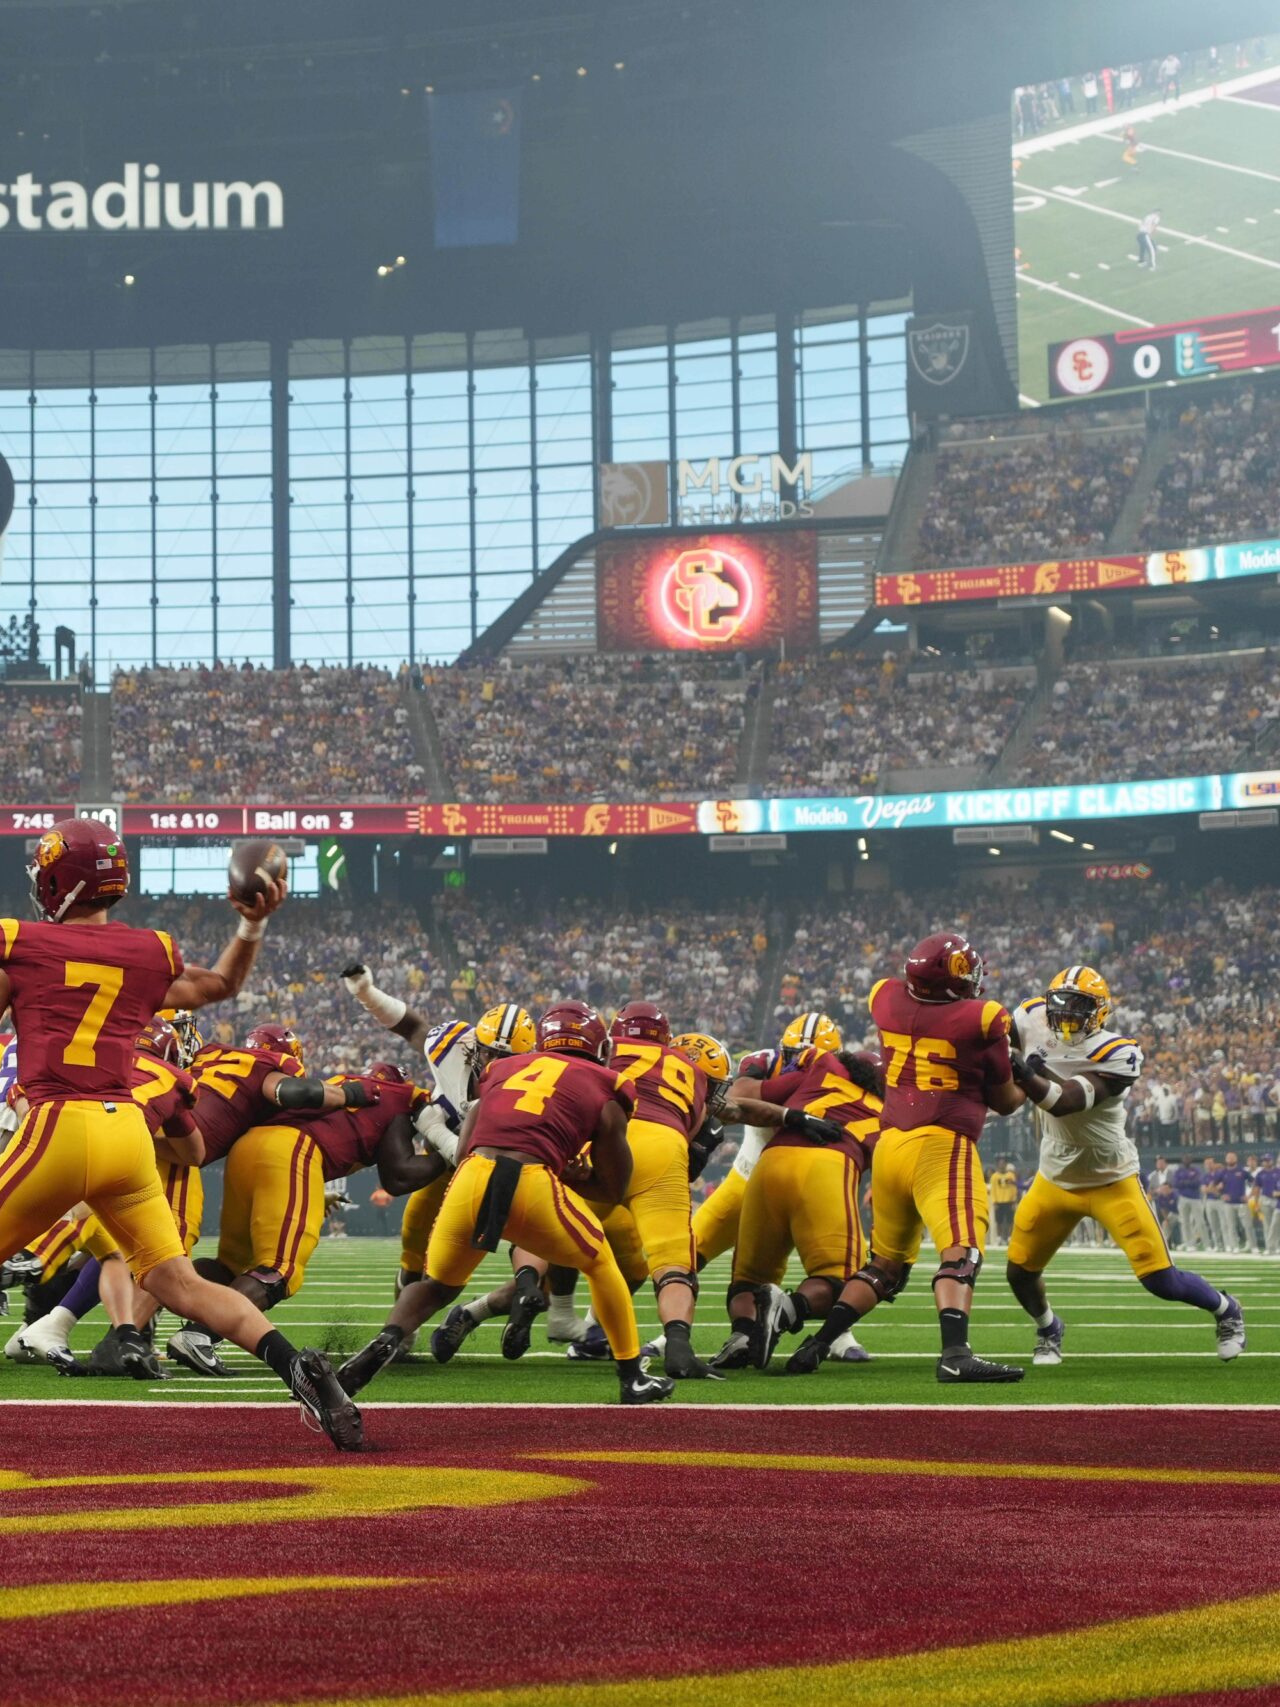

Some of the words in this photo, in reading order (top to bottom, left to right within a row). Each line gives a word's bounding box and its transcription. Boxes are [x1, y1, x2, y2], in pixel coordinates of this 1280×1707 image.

[1133, 345, 1161, 379] 0
[677, 453, 814, 496] MGM
[677, 499, 815, 526] REWARDS
[951, 577, 1001, 591] TROJANS
[795, 806, 848, 826] Modelo
[854, 795, 936, 829] Vegas
[945, 789, 1070, 822] KICKOFF
[1078, 781, 1195, 814] CLASSIC
[12, 813, 55, 830] 7:45
[150, 813, 178, 830] 1st
[255, 811, 297, 830] Ball
[301, 814, 331, 830] on
[339, 811, 354, 830] 3
[499, 814, 549, 825] TROJANS
[63, 961, 124, 1067] 7
[544, 1038, 566, 1049] FIGHT
[568, 1038, 583, 1048] ON!
[880, 1030, 959, 1091] 76
[1126, 1052, 1137, 1072] 4
[503, 1056, 570, 1116] 4
[613, 1043, 696, 1114] 79
